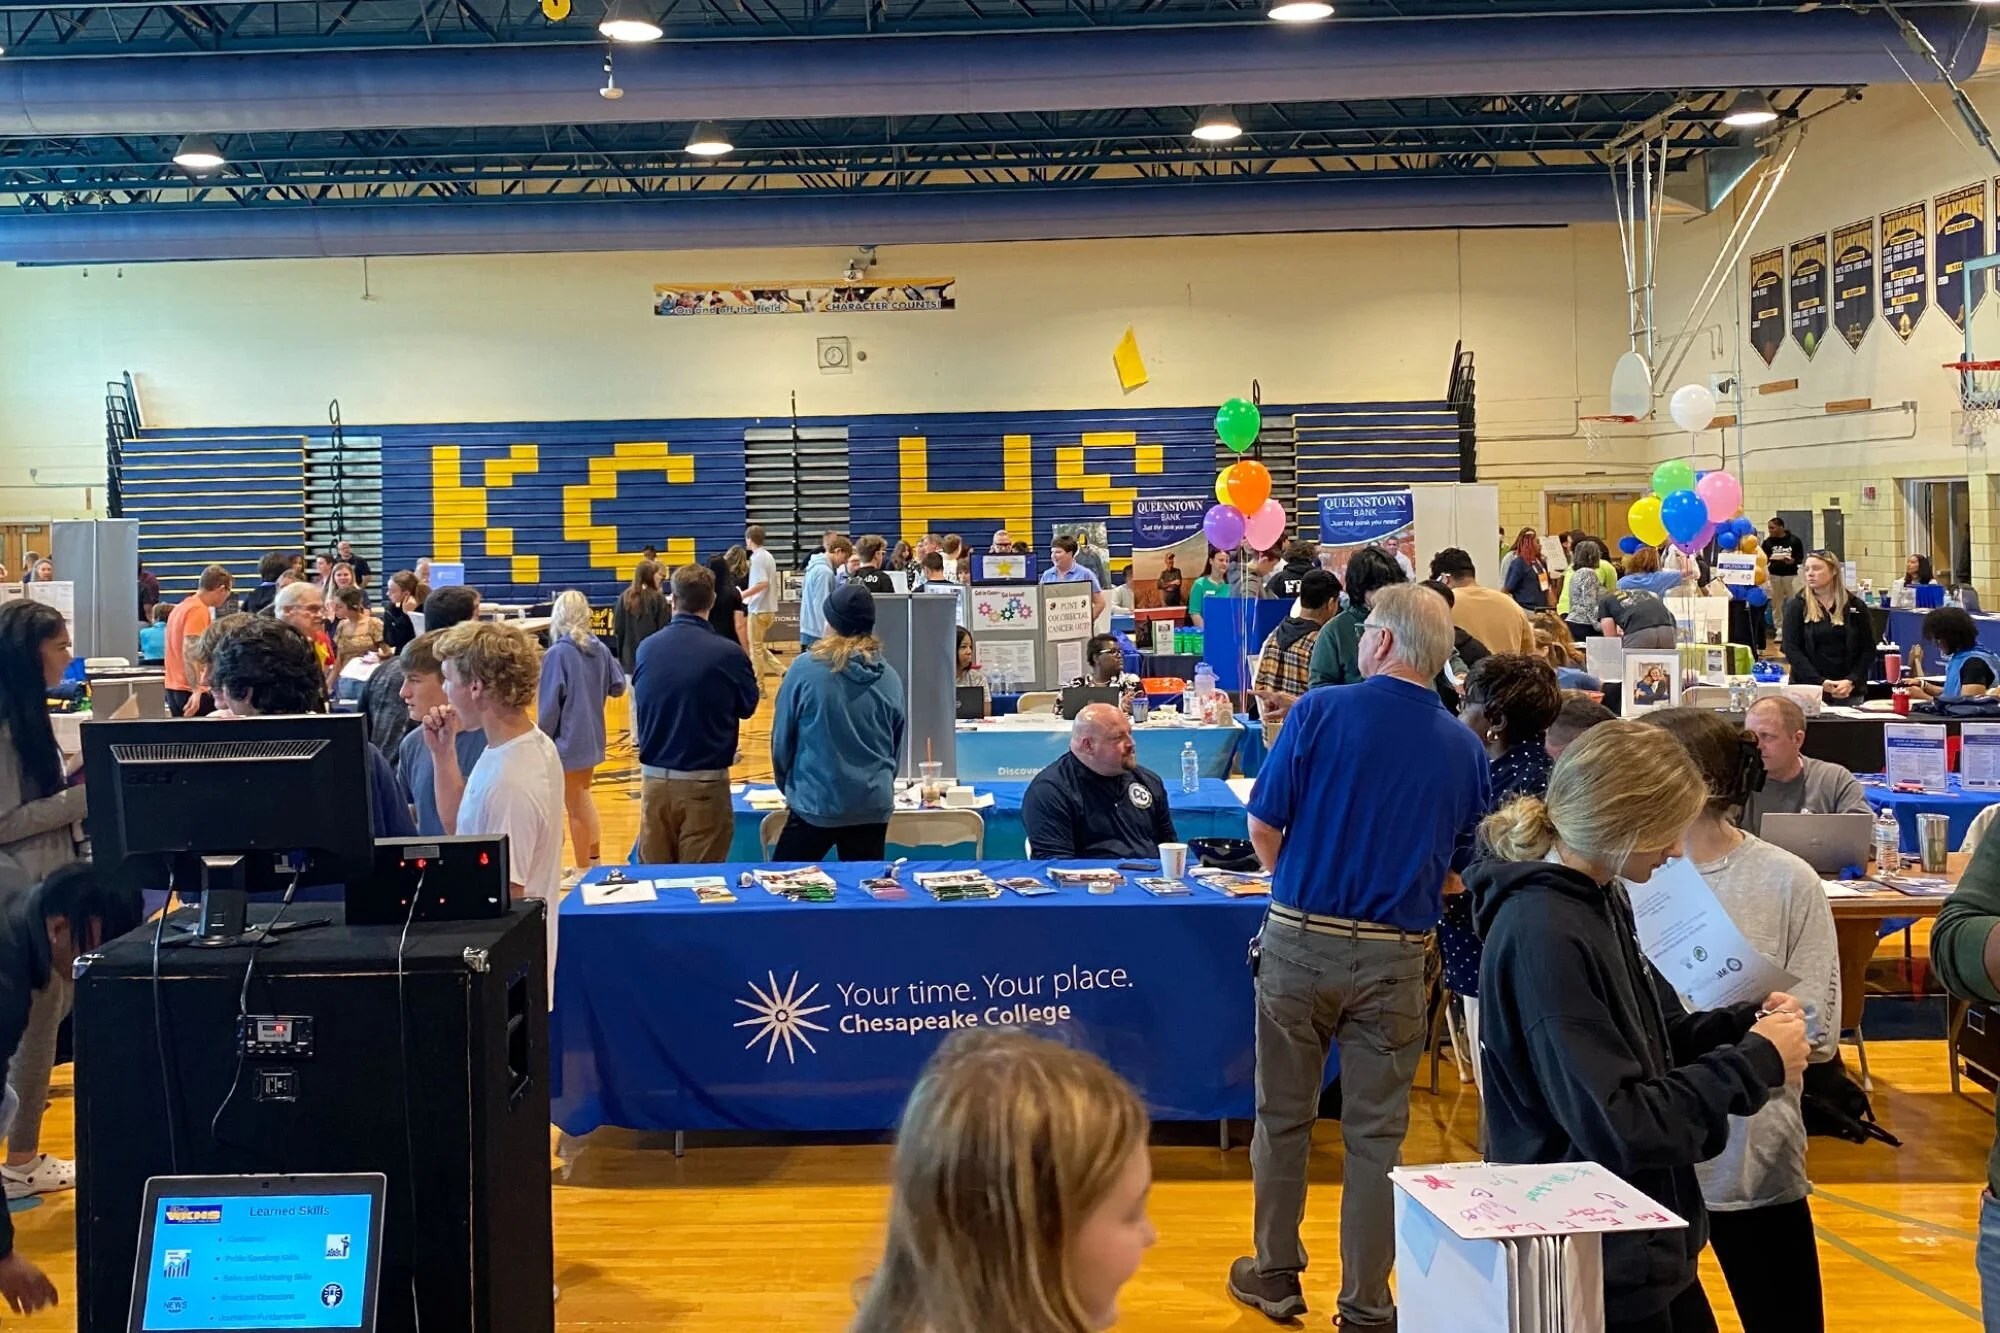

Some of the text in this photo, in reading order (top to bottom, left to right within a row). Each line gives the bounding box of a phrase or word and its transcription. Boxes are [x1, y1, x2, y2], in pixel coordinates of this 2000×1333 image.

[676, 305, 694, 315] On
[696, 304, 716, 315] and
[719, 303, 736, 314] off
[737, 303, 755, 313] the
[825, 299, 941, 312] CHARACTER COUNTS!
[1137, 500, 1204, 514] QUEENSTOWN
[1324, 495, 1406, 510] QUEENSTOWN
[1160, 513, 1181, 521] BANK
[1353, 508, 1378, 517] BANK
[1371, 519, 1382, 527] you
[1060, 602, 1078, 611] PUNT
[1048, 612, 1089, 623] COLORECTAL
[1048, 624, 1074, 633] CANCER
[835, 964, 1134, 1008] Your time. Your place.
[839, 1003, 1072, 1036] Chesapeake College
[249, 1205, 330, 1217] Learned Skills
[164, 1301, 187, 1309] NEWS
